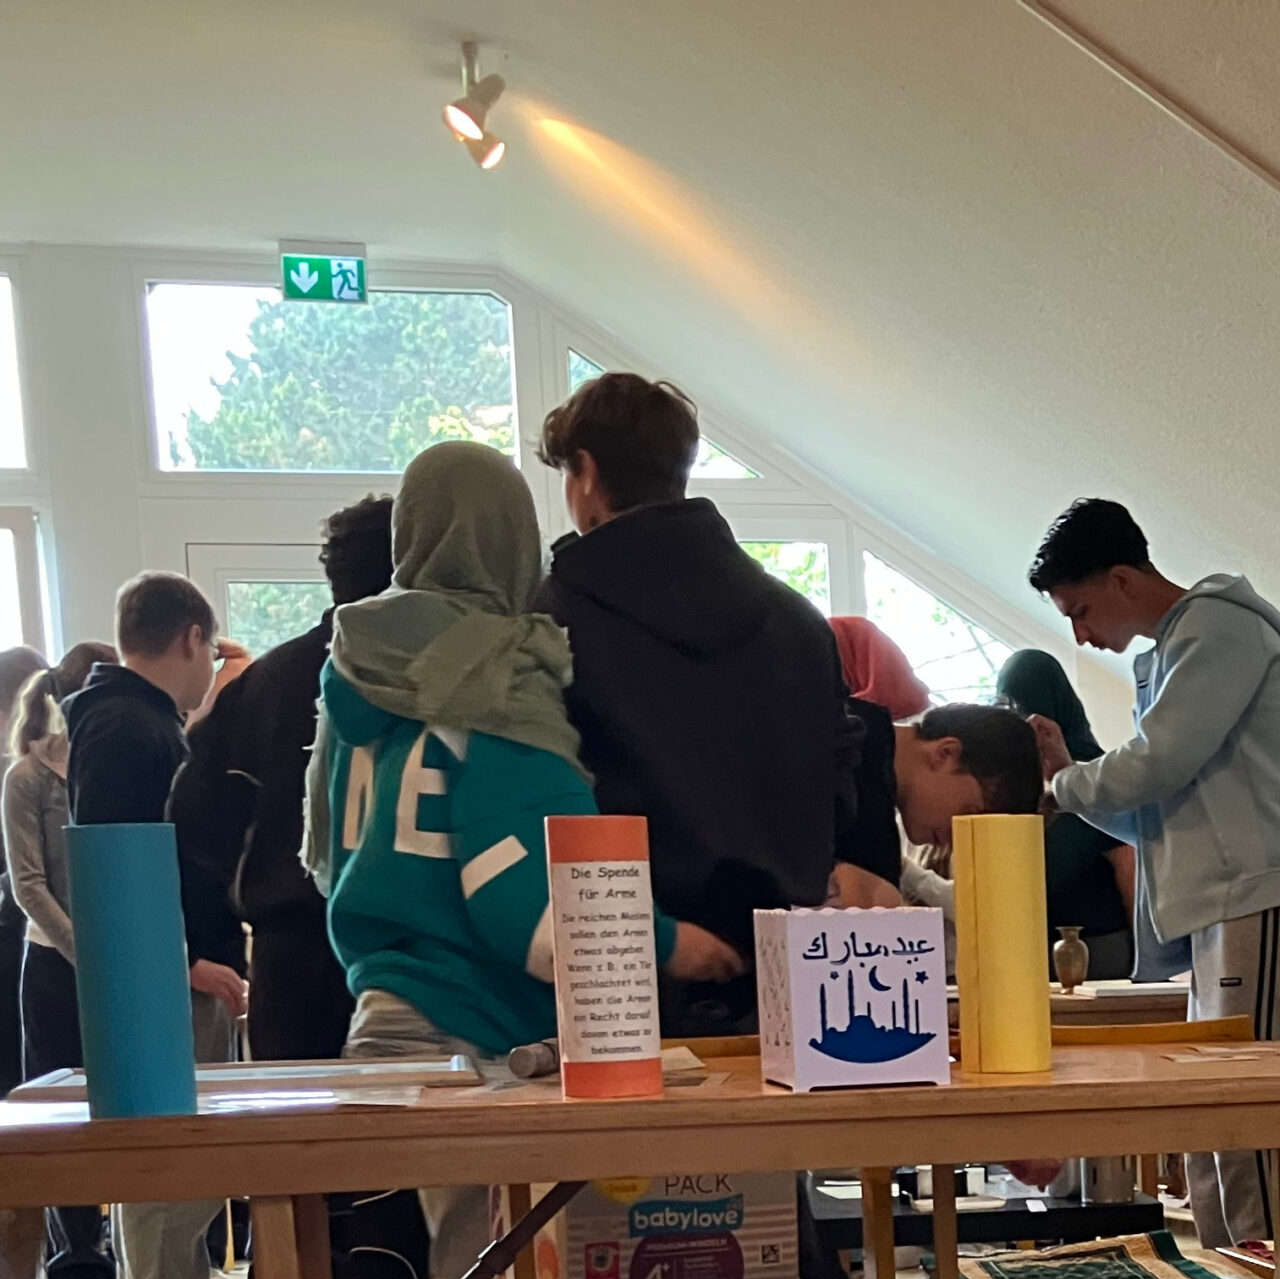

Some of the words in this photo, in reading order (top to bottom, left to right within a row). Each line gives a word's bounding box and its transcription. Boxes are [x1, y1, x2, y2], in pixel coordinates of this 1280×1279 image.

[571, 867, 591, 879] Die
[598, 867, 640, 881] Spende
[578, 888, 599, 902] für
[605, 888, 637, 898] Arme
[579, 912, 617, 922] reichen
[570, 930, 596, 939] sollen
[574, 948, 602, 956] etwas
[803, 932, 889, 967] مبارك
[892, 937, 935, 964] عيد
[590, 1011, 620, 1021] Recht
[612, 1028, 640, 1037] etwas
[665, 1173, 732, 1196] PACK
[634, 1207, 738, 1230] babylove
